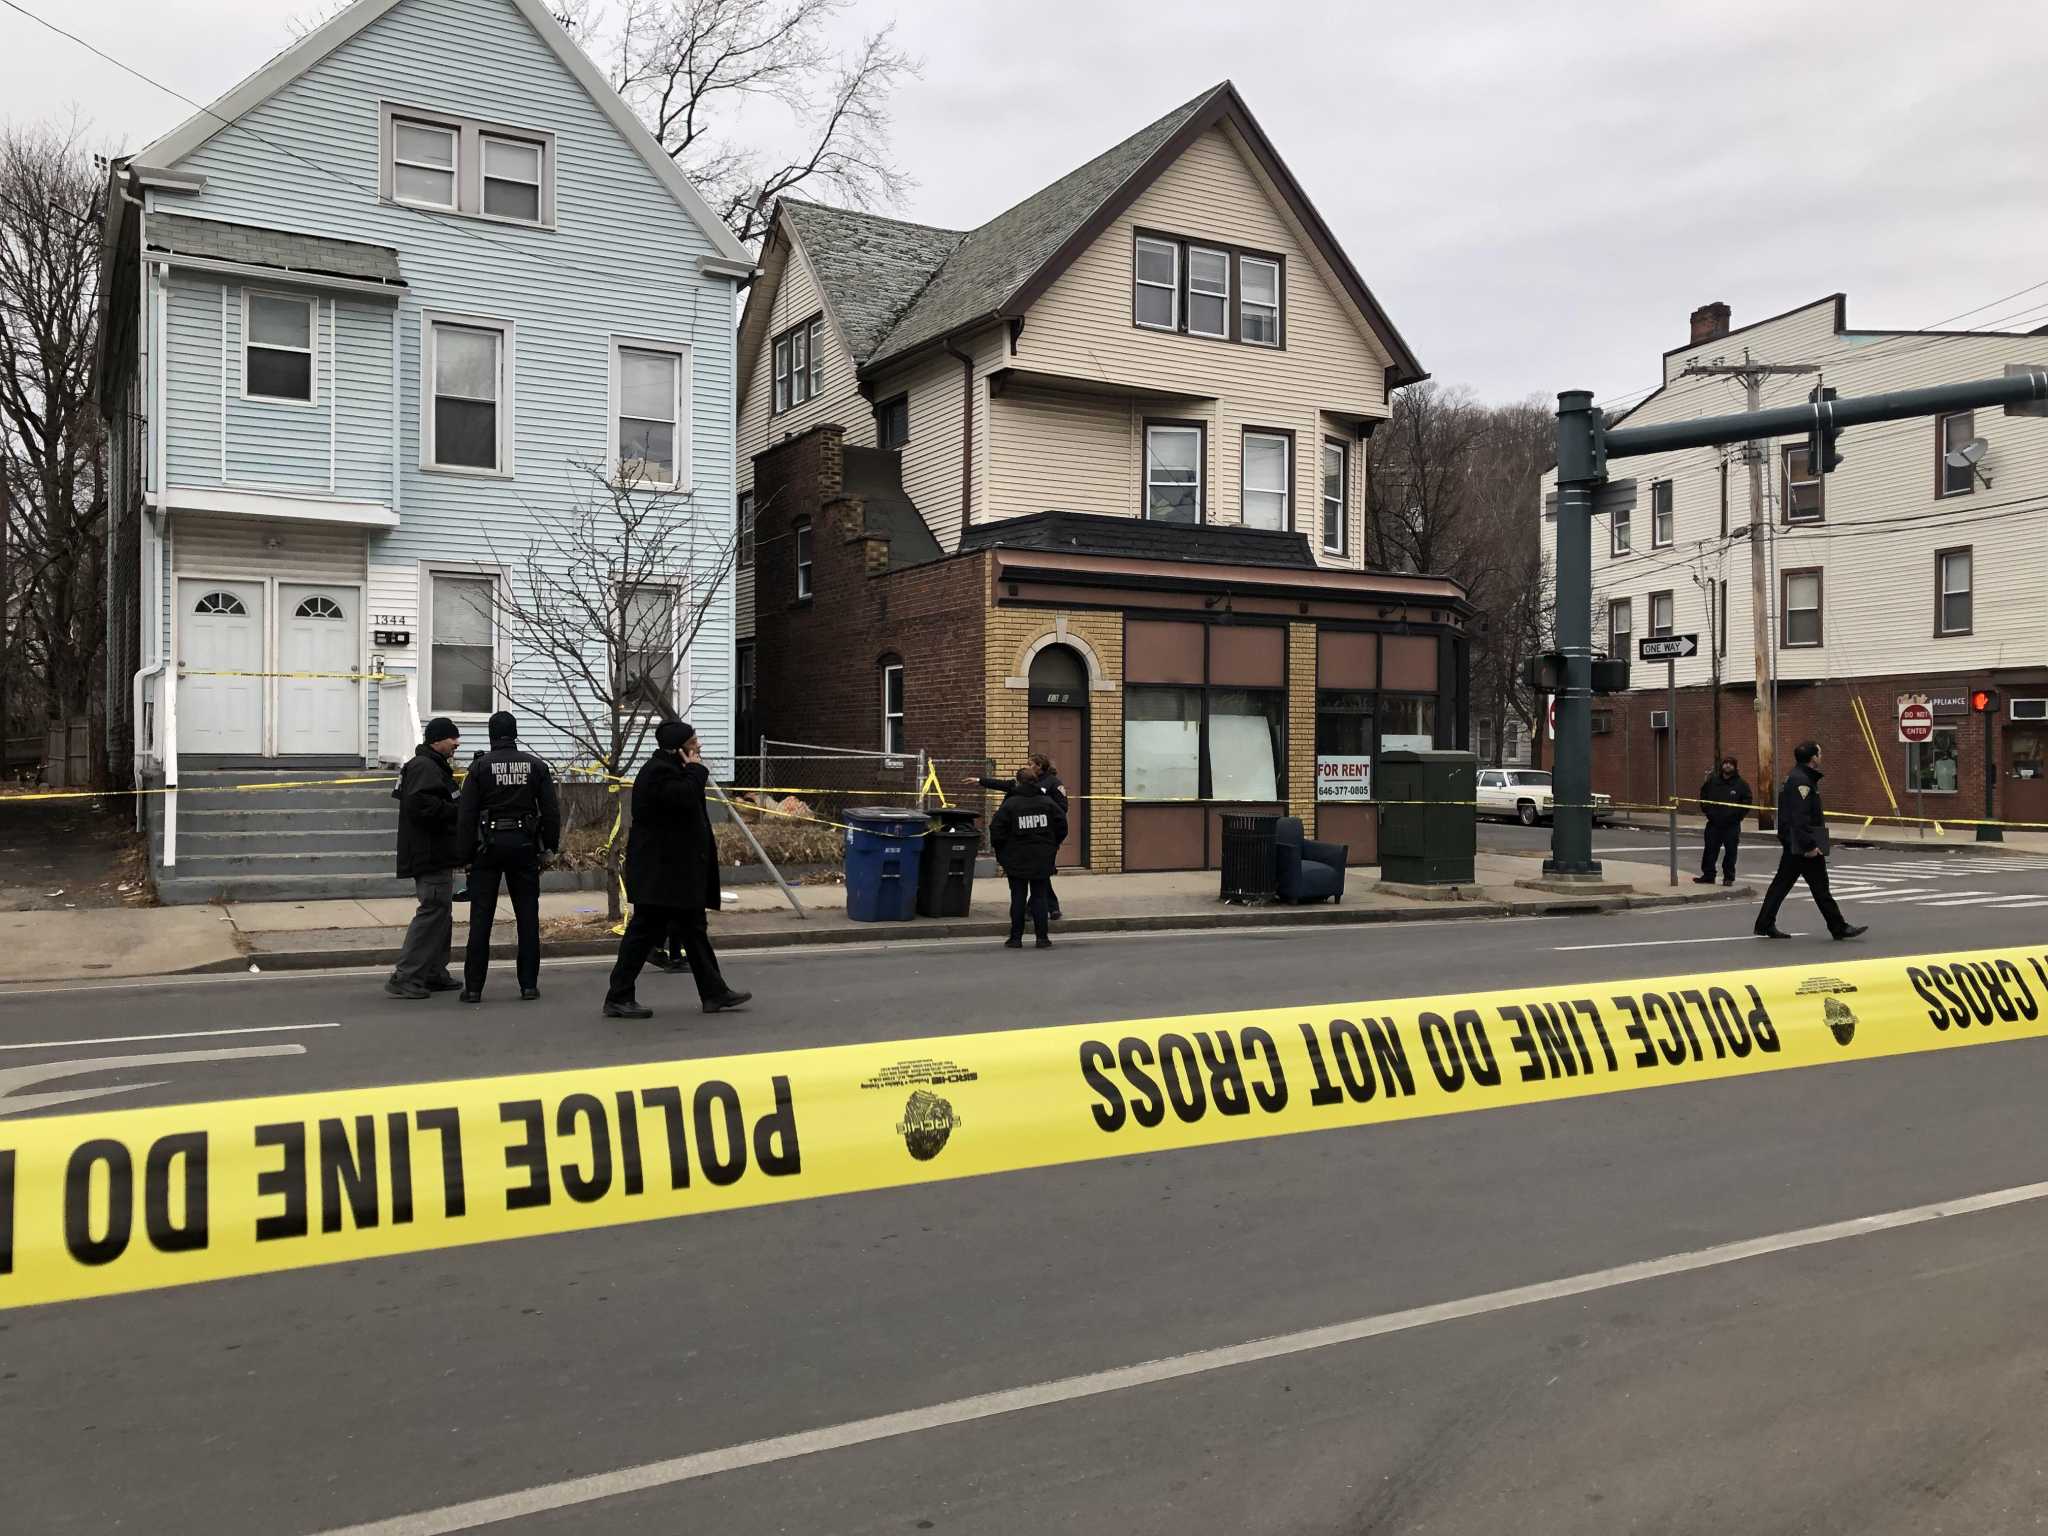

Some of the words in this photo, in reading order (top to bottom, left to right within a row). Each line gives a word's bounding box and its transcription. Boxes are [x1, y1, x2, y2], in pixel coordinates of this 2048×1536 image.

[375, 614, 406, 625] 1344
[1645, 643, 1661, 653] ONE
[1664, 641, 1680, 652] WAY
[491, 762, 507, 774] NEW
[509, 761, 531, 774] HAVEN
[496, 773, 528, 785] POLICE
[1318, 763, 1338, 777] FOR
[1342, 763, 1369, 777] RENT
[1018, 814, 1048, 829] NHPD
[1611, 984, 1781, 1068] POLICE
[1906, 959, 2039, 1031] CROSS
[1079, 1026, 1288, 1132] CROSS
[1298, 1016, 1416, 1106] NOT
[1418, 1009, 1502, 1093] DO
[1496, 999, 1619, 1082] LINE
[254, 1107, 466, 1243] LINE
[499, 1075, 801, 1212] POLICE
[63, 1131, 208, 1267] DO
